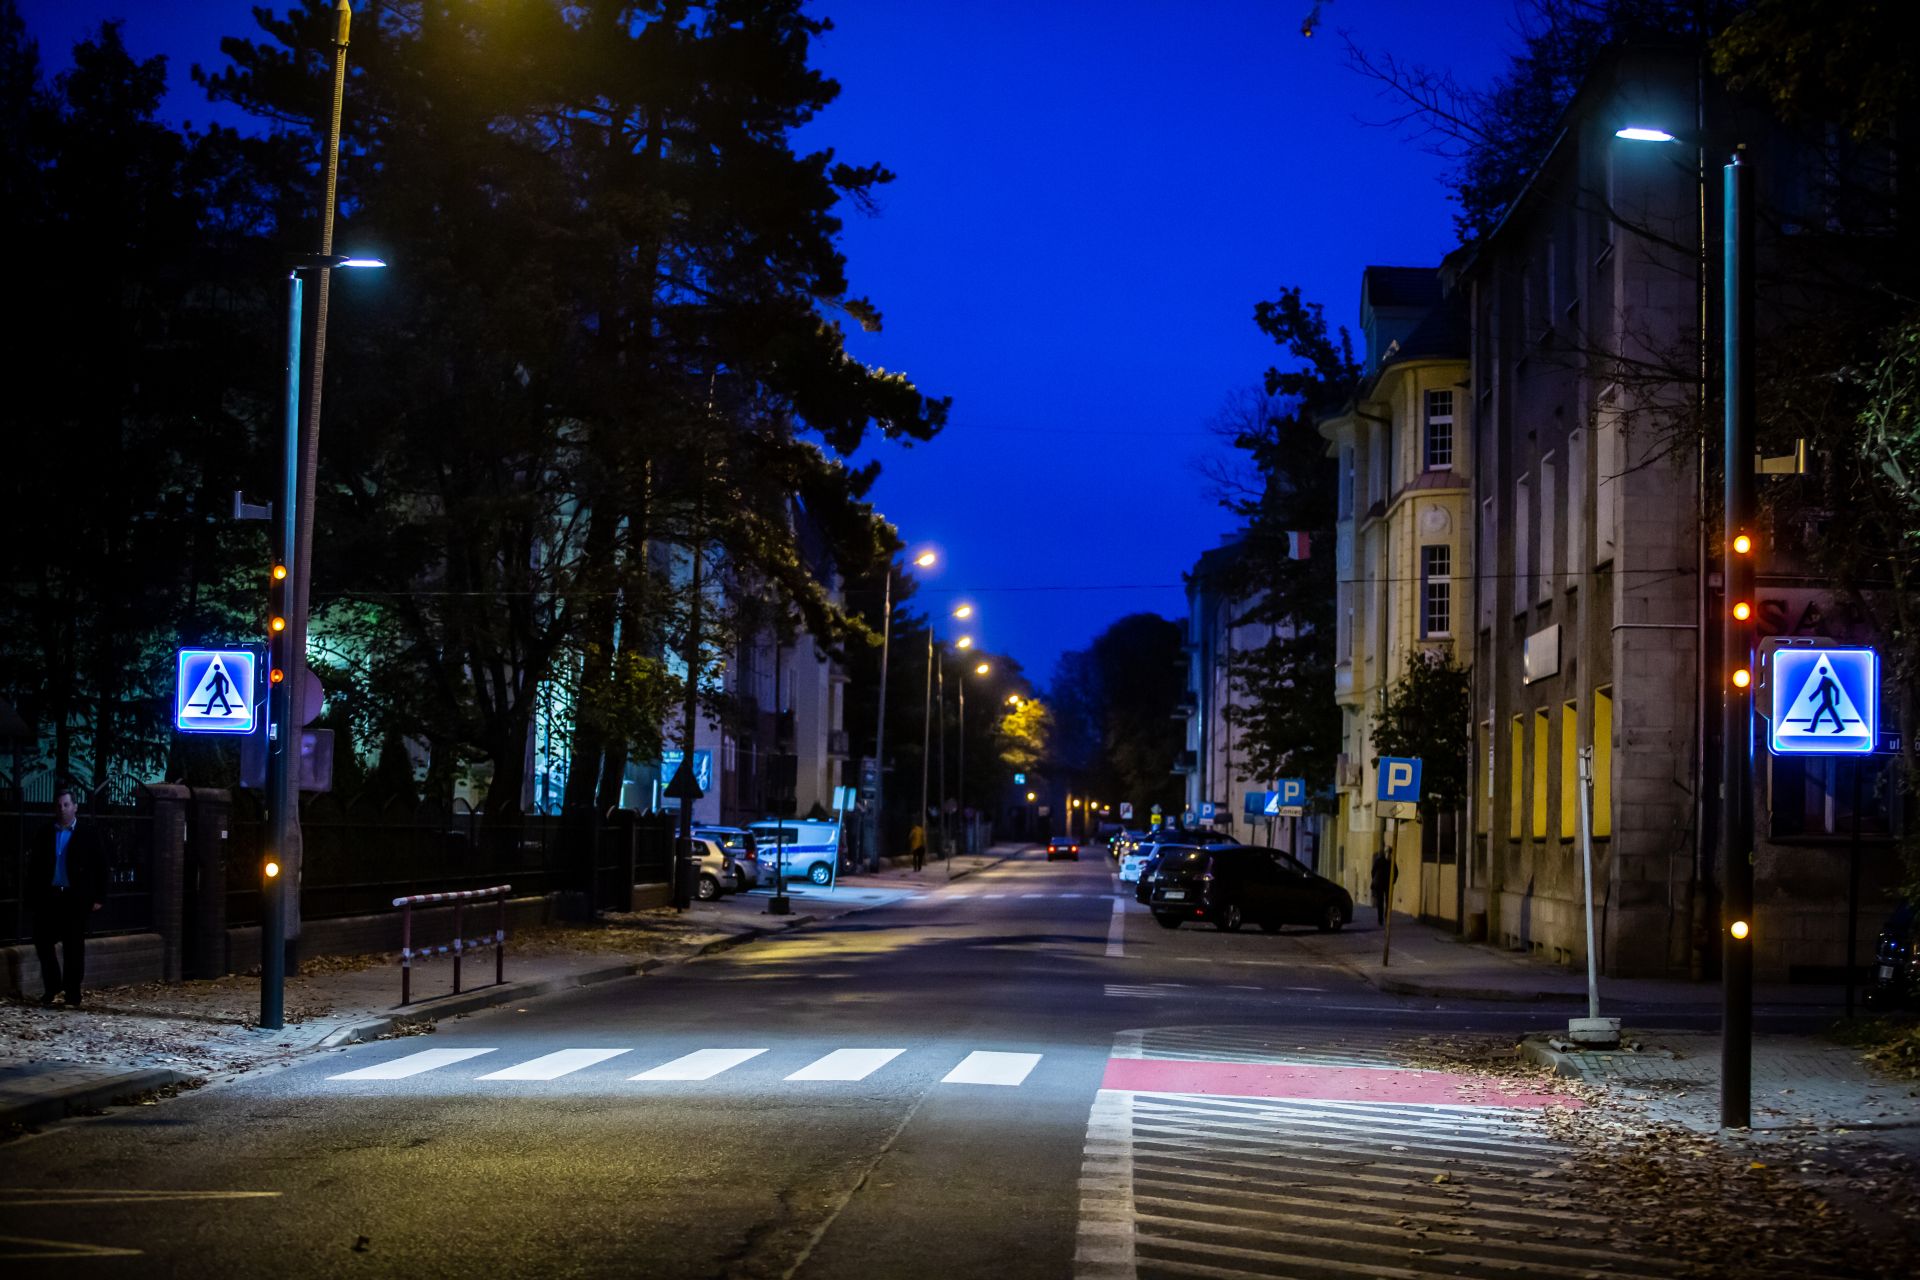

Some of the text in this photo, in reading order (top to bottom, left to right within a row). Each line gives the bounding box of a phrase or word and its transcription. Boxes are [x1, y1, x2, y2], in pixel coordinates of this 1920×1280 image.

[1387, 762, 1412, 795] P
[1284, 781, 1300, 802] P
[1202, 803, 1212, 817] P
